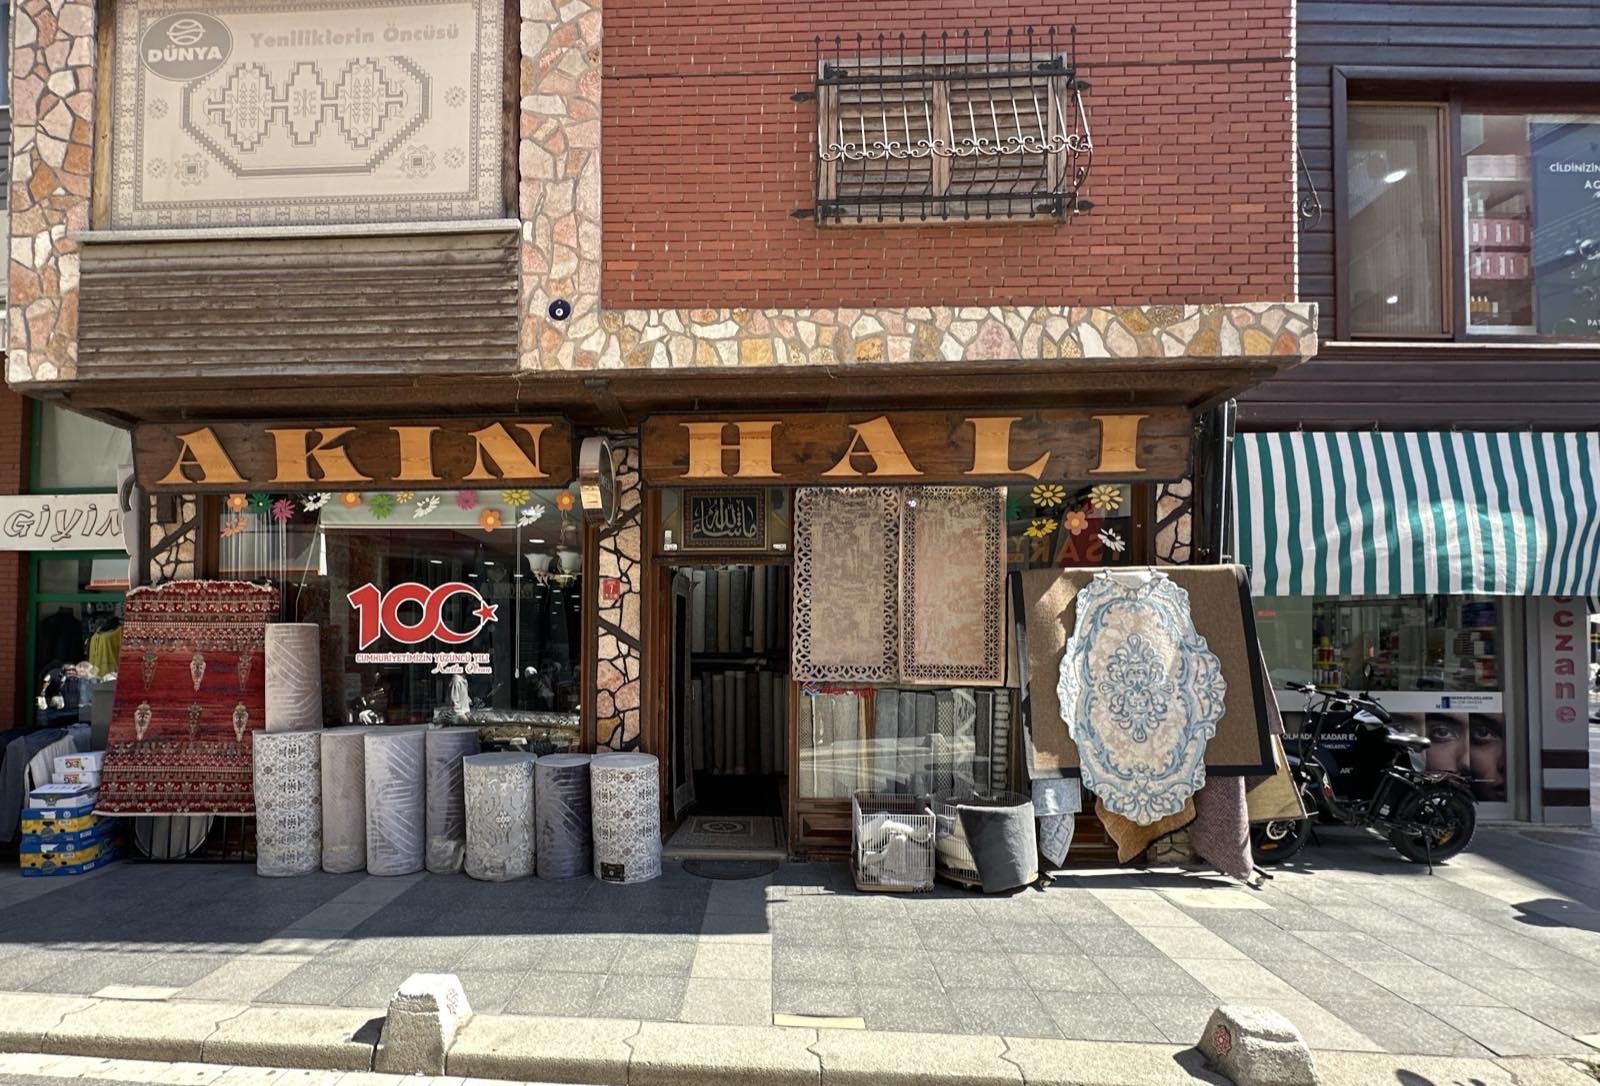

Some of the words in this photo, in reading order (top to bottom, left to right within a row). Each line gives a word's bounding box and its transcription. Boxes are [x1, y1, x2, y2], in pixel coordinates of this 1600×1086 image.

[250, 27, 375, 48] Yeniliklerin
[383, 23, 460, 44] Öncüsü
[147, 45, 223, 63] DÜNYA
[155, 421, 553, 485] AKIN
[680, 414, 1150, 481] HALI
[355, 652, 432, 663] CUMHURİYETİMİZİN
[432, 652, 472, 663] YÜZÜNCÜ
[1320, 733, 1347, 741] KADAR
